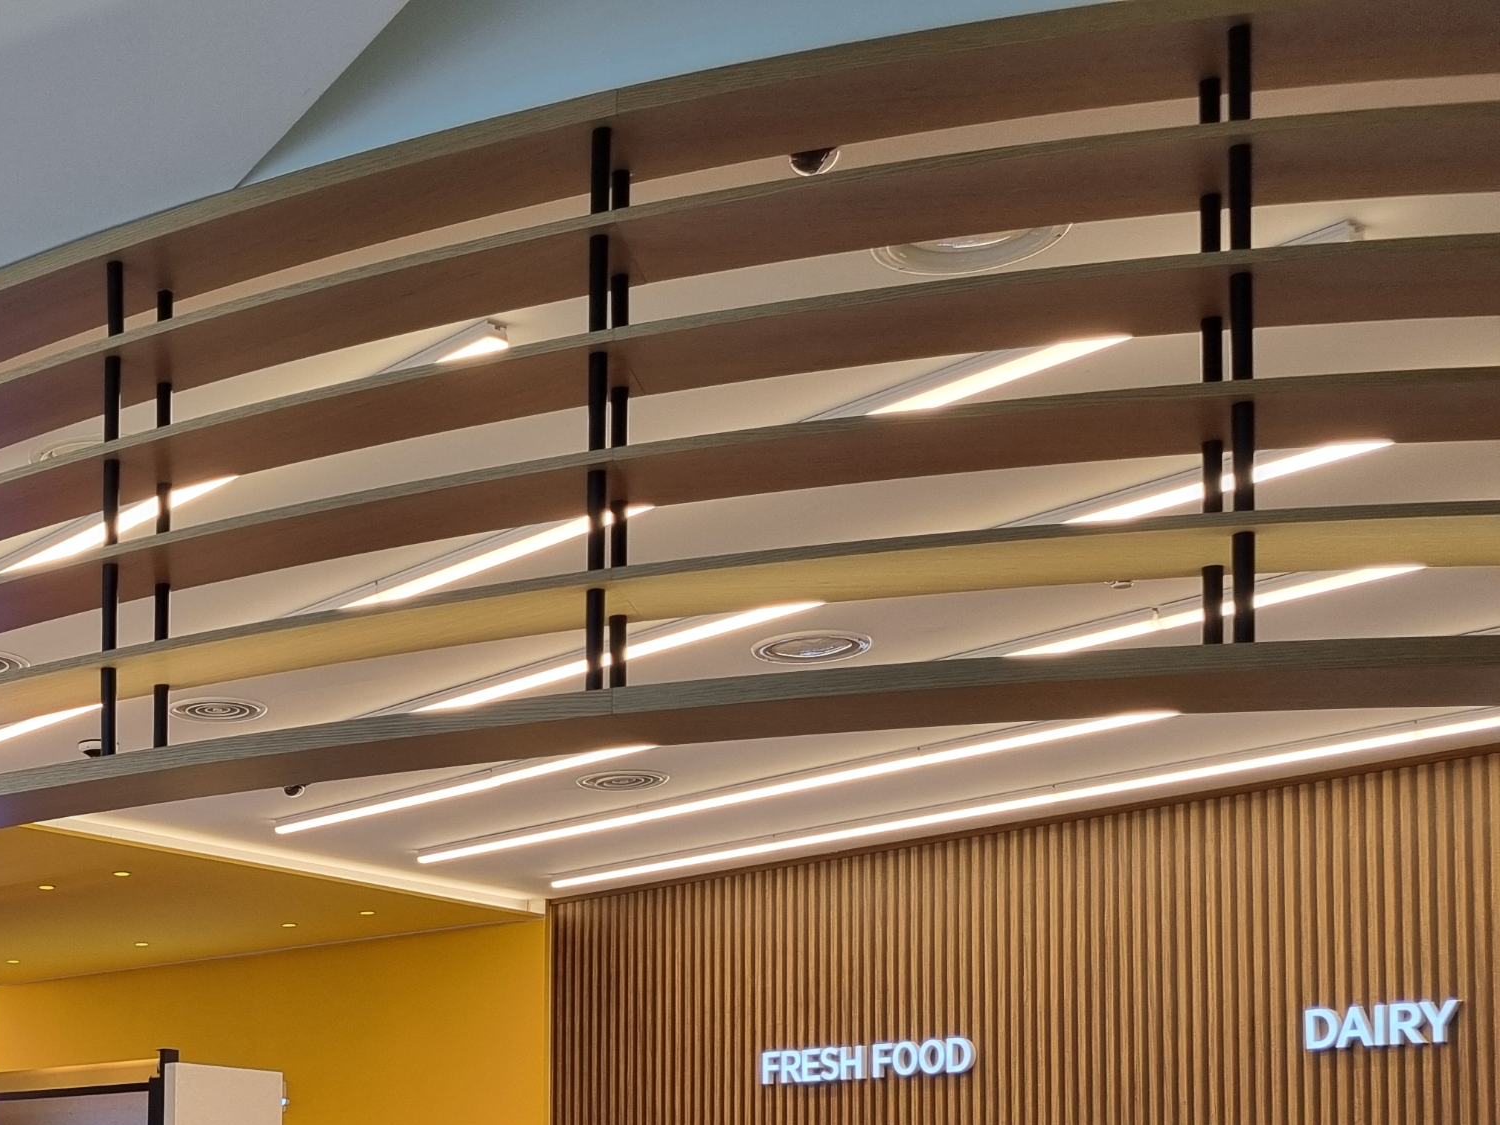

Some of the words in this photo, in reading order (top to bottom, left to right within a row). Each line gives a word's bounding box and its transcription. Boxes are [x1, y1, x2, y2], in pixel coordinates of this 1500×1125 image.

[1304, 999, 1462, 1050] DAIRY
[761, 1044, 866, 1085] FRESH
[872, 1037, 976, 1079] FOOD
